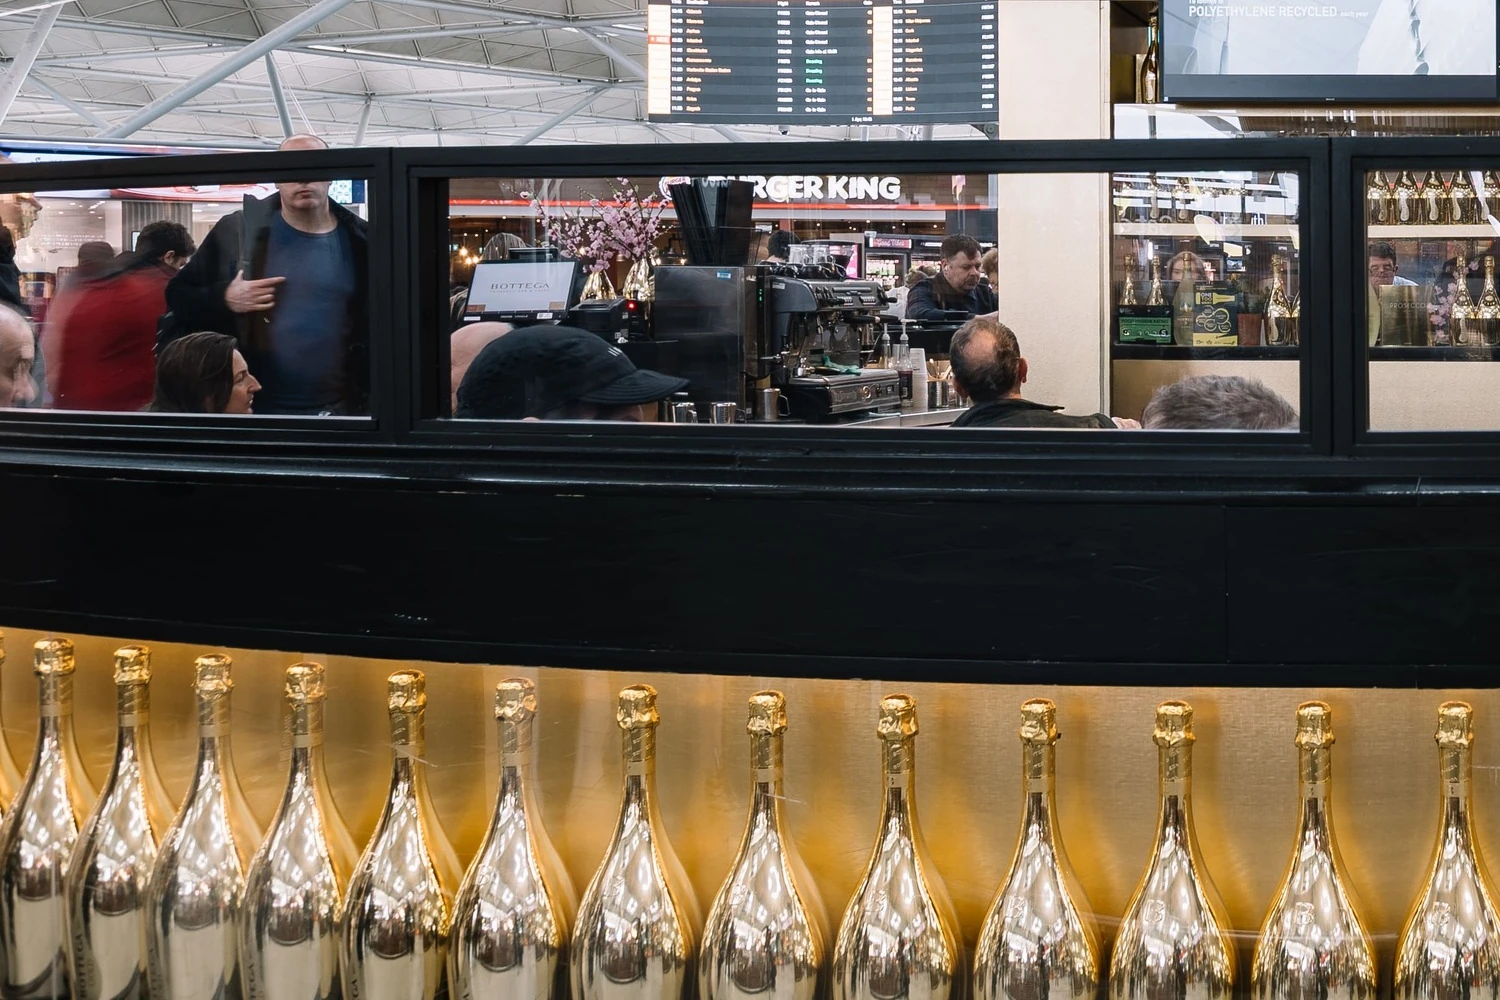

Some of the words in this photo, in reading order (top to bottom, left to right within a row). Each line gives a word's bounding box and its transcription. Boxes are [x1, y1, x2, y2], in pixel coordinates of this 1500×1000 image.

[1188, 6, 1276, 17] POLYETHYLENE
[1279, 6, 1337, 17] RECYCLED
[708, 175, 824, 200] RGER
[827, 175, 901, 200] KING
[490, 282, 550, 290] BOTTEGA
[74, 933, 86, 1000] BOTTEGA
